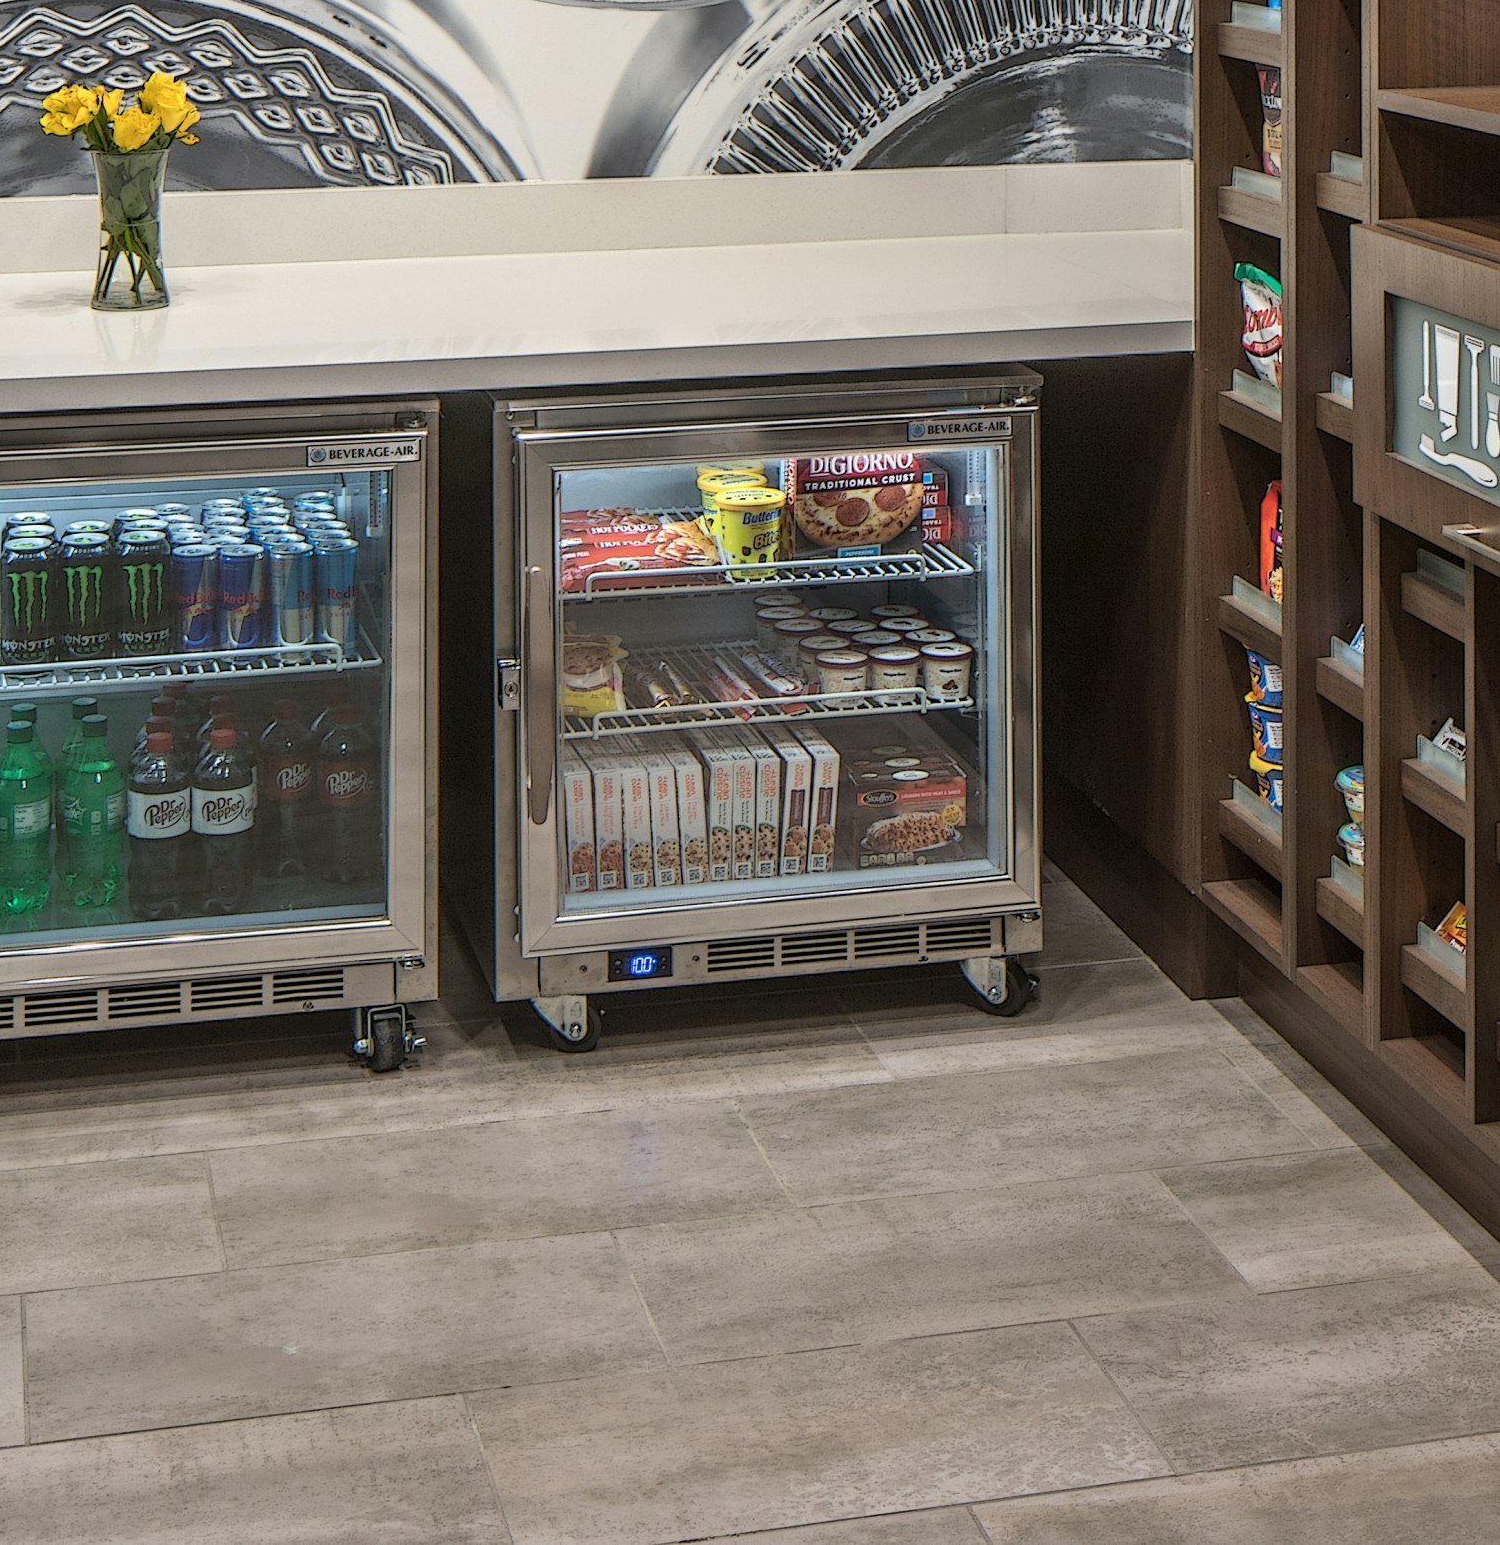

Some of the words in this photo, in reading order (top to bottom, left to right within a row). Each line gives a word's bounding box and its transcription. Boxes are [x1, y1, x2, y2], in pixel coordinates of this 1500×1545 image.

[804, 477, 879, 492] TRADITIONAL
[881, 472, 916, 485] CRUST
[161, 799, 176, 814] Dr
[205, 800, 243, 822] Pepper
[218, 796, 235, 811] Dr
[148, 802, 185, 826] Pepper
